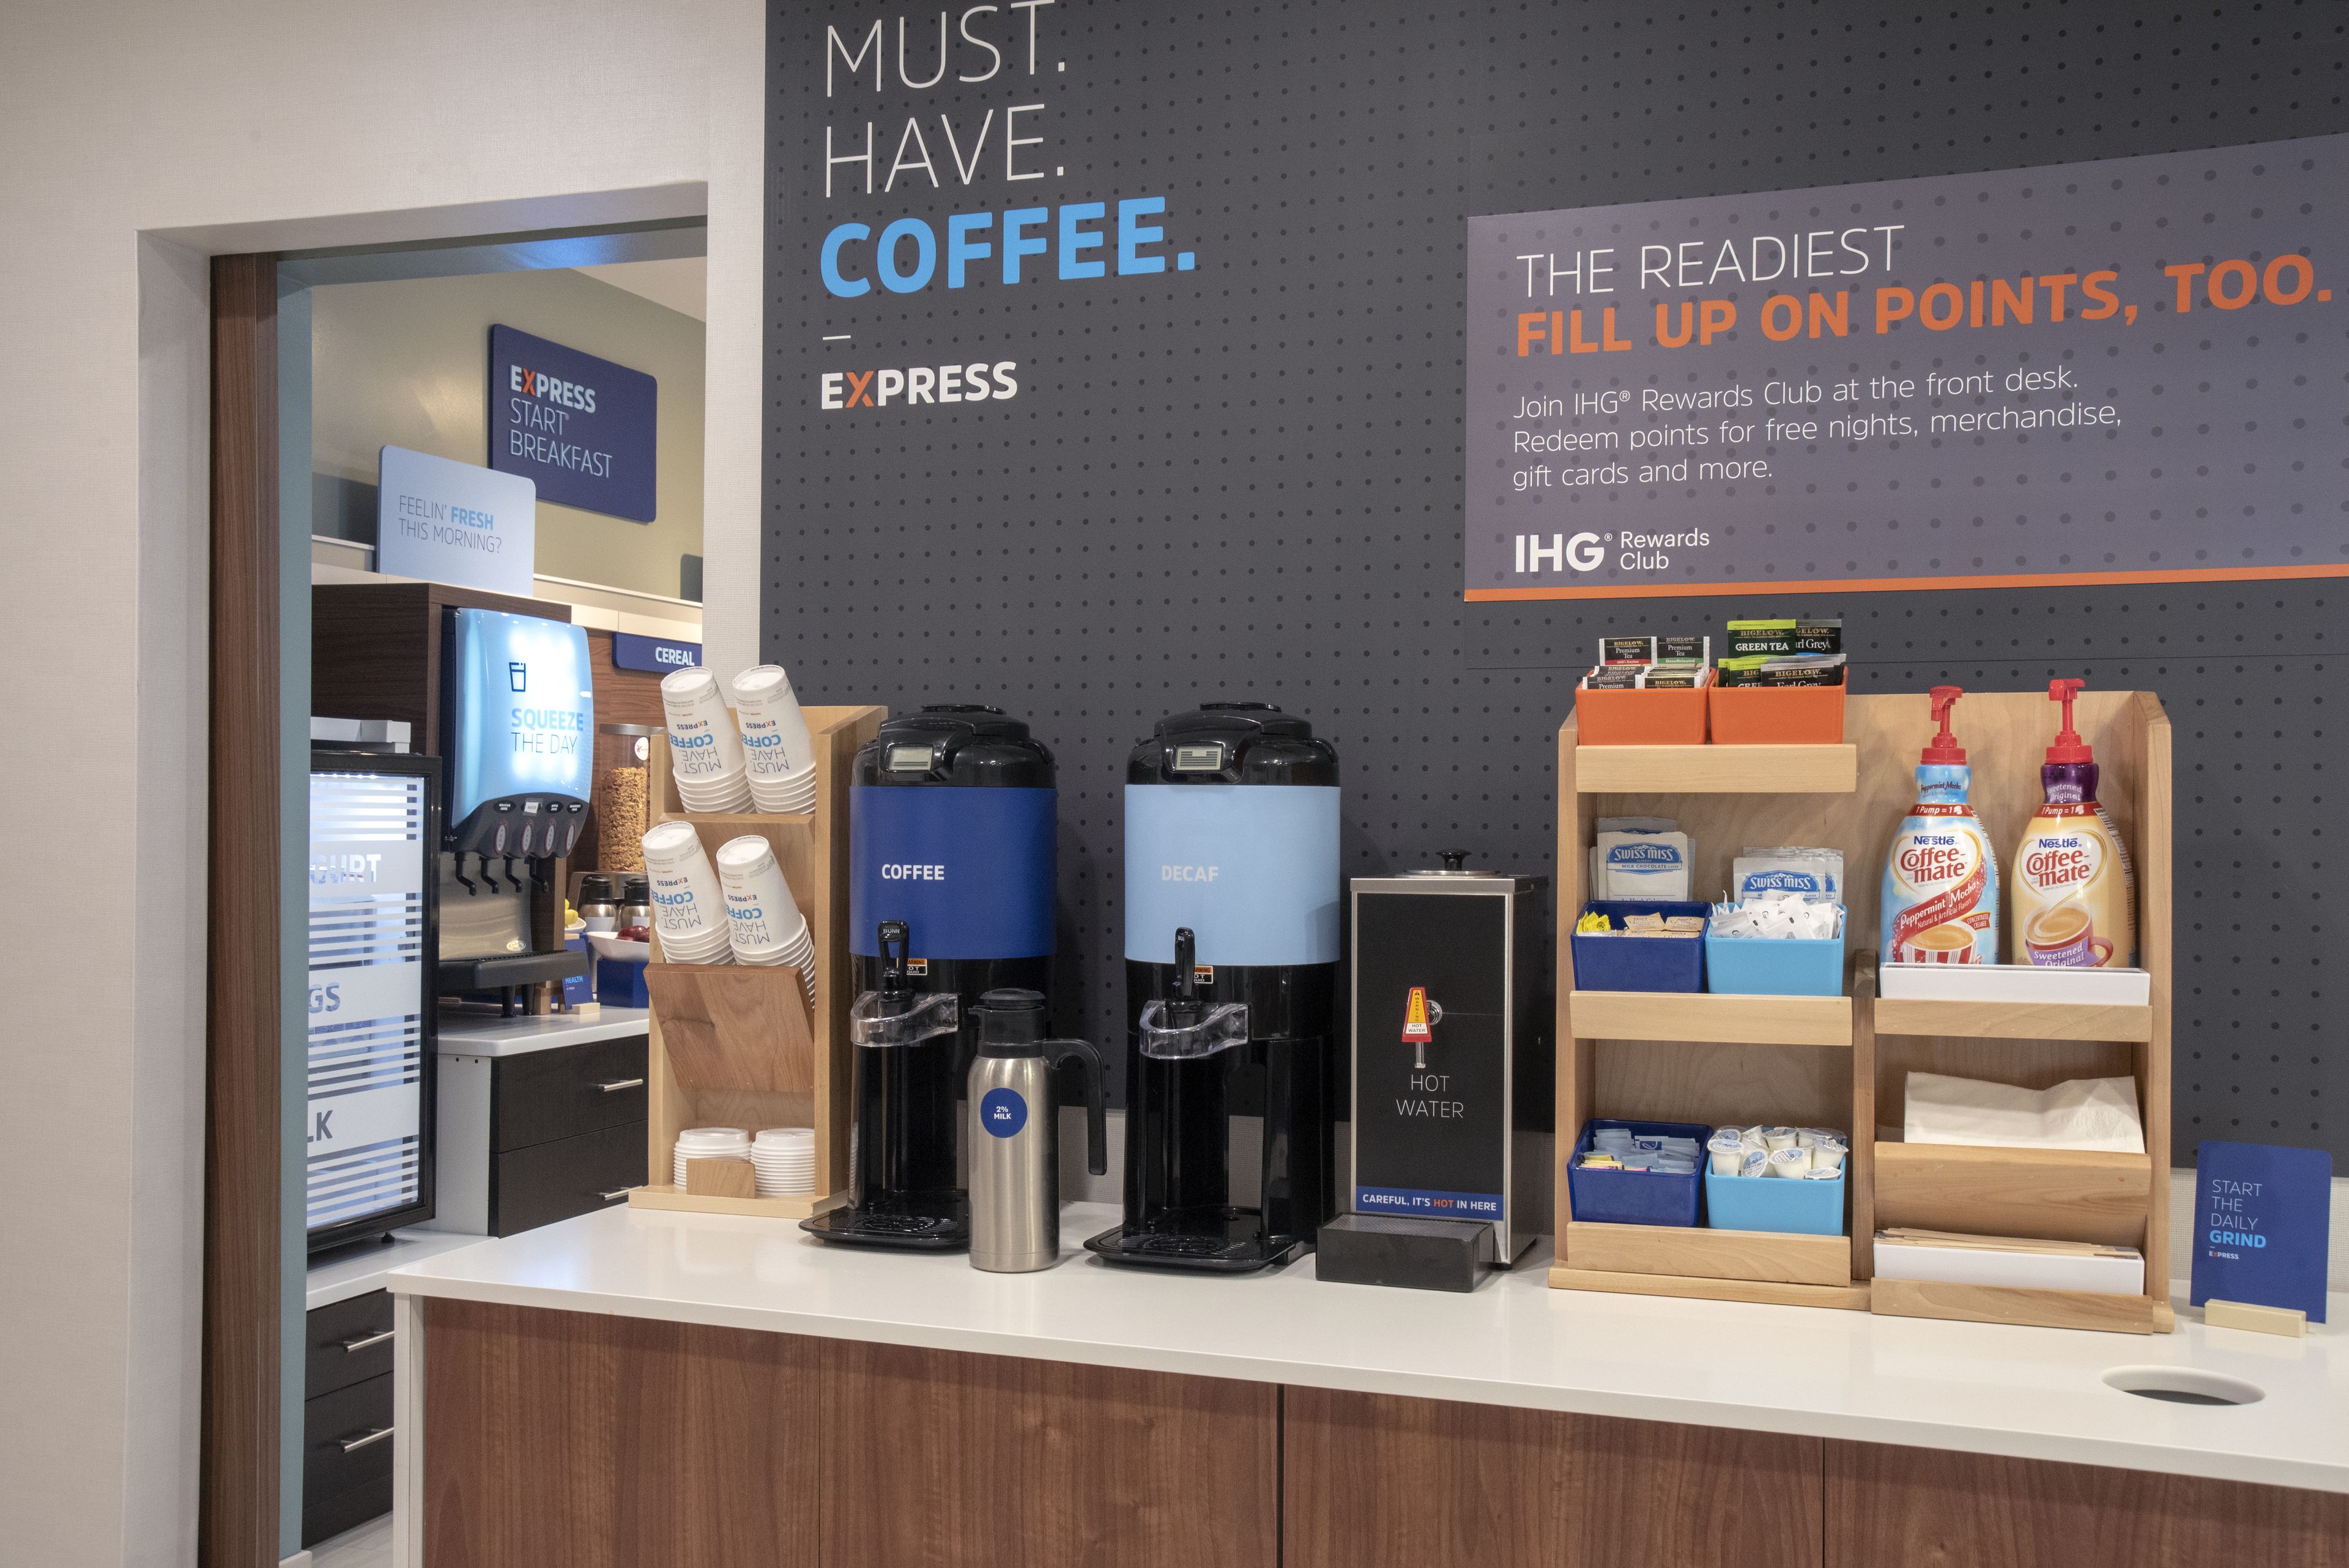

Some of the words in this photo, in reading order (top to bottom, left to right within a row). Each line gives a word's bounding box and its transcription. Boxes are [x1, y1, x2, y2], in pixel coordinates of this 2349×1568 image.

[827, 0, 1065, 97] MUST.
[826, 103, 1064, 198] HAVE.
[820, 196, 1195, 298] COFFEE.
[1516, 248, 1614, 297] THE
[1641, 226, 1904, 289] READIEST
[1518, 308, 1631, 357] FILL
[1657, 300, 1736, 348] UP
[1761, 291, 1848, 341] ON
[1876, 270, 2137, 334] POINTS,
[2165, 254, 2331, 312] TOO.
[511, 364, 596, 413] EXPRESS
[822, 361, 1018, 410] EXPRESS
[1513, 396, 1562, 418] Join
[1643, 384, 1753, 411] Rewards
[1764, 381, 1822, 405] Club
[1833, 380, 1860, 401] at
[1870, 375, 1914, 399] the
[1926, 369, 1993, 397] front
[2005, 365, 2077, 391] desk.
[1514, 429, 1618, 453] Redeem
[1630, 424, 1709, 450] points
[1719, 421, 1755, 443] for
[1765, 418, 1817, 441] free
[1828, 411, 1918, 440] nights,
[1931, 402, 2121, 433] merchandise,
[511, 429, 612, 478] BREAKFAST
[1513, 466, 1551, 490] gift
[1562, 462, 1628, 486] cards
[1639, 459, 1687, 483] and
[1699, 459, 1772, 480] more.
[399, 495, 447, 520] FEELIN'
[451, 506, 494, 530] FRESH
[398, 518, 428, 540] THIS
[434, 525, 502, 553] MORNING?
[1620, 528, 1710, 549] Rewards
[1619, 552, 1669, 570] Club
[1735, 642, 1768, 651] GREEN
[1806, 638, 1828, 651] Grey
[655, 647, 695, 666] CEREAL
[511, 708, 584, 731] SQUEEZE
[677, 720, 708, 730] EXPRESS
[746, 720, 776, 729] EXPRESS
[511, 732, 543, 753] THE
[551, 734, 577, 754] DAY
[679, 746, 718, 761] HAVE.
[748, 747, 785, 761] HAVE.
[682, 758, 722, 774] MUST.
[1921, 782, 1945, 794] Peppermint
[1945, 781, 1961, 790] Mocha
[2047, 783, 2082, 794] Sweetened
[2050, 792, 2080, 802] Original
[1920, 806, 1940, 815] Pump
[2045, 807, 2063, 815] Pump
[309, 854, 382, 884] GURT
[881, 864, 944, 881] COFFEE
[1162, 865, 1219, 882] DECAF
[1913, 862, 1965, 883] mate
[2038, 865, 2090, 887] mate
[657, 877, 688, 887] EXPRESS
[728, 894, 757, 903] EXPRESS
[1901, 899, 1945, 929] Peppermint
[1949, 881, 1976, 908] Mocha
[659, 903, 697, 917] HAVE.
[1918, 919, 1933, 929] Natural
[1939, 905, 1957, 919] Artificial
[1959, 898, 1972, 911] Flavors
[1967, 914, 1989, 924] CONCENTRATED
[1974, 920, 1986, 929] CREAMER
[2034, 942, 2083, 960] Sweetened
[2046, 952, 2084, 966] Original
[565, 975, 583, 984] HEALTH
[1411, 1074, 1450, 1092] HOT
[1396, 1099, 1464, 1119] WATER
[2212, 1179, 2263, 1197] START
[1362, 1194, 1409, 1207] CAREFUL,
[1412, 1197, 1431, 1207] IT'S
[1433, 1199, 1454, 1208] HOT
[1457, 1200, 1468, 1209] IN
[1471, 1201, 1496, 1211] HERE
[2211, 1196, 2243, 1212] THE
[2211, 1213, 2258, 1230] DAILY
[2210, 1230, 2266, 1248] GRIND
[2209, 1251, 2239, 1260] EXPRESS
